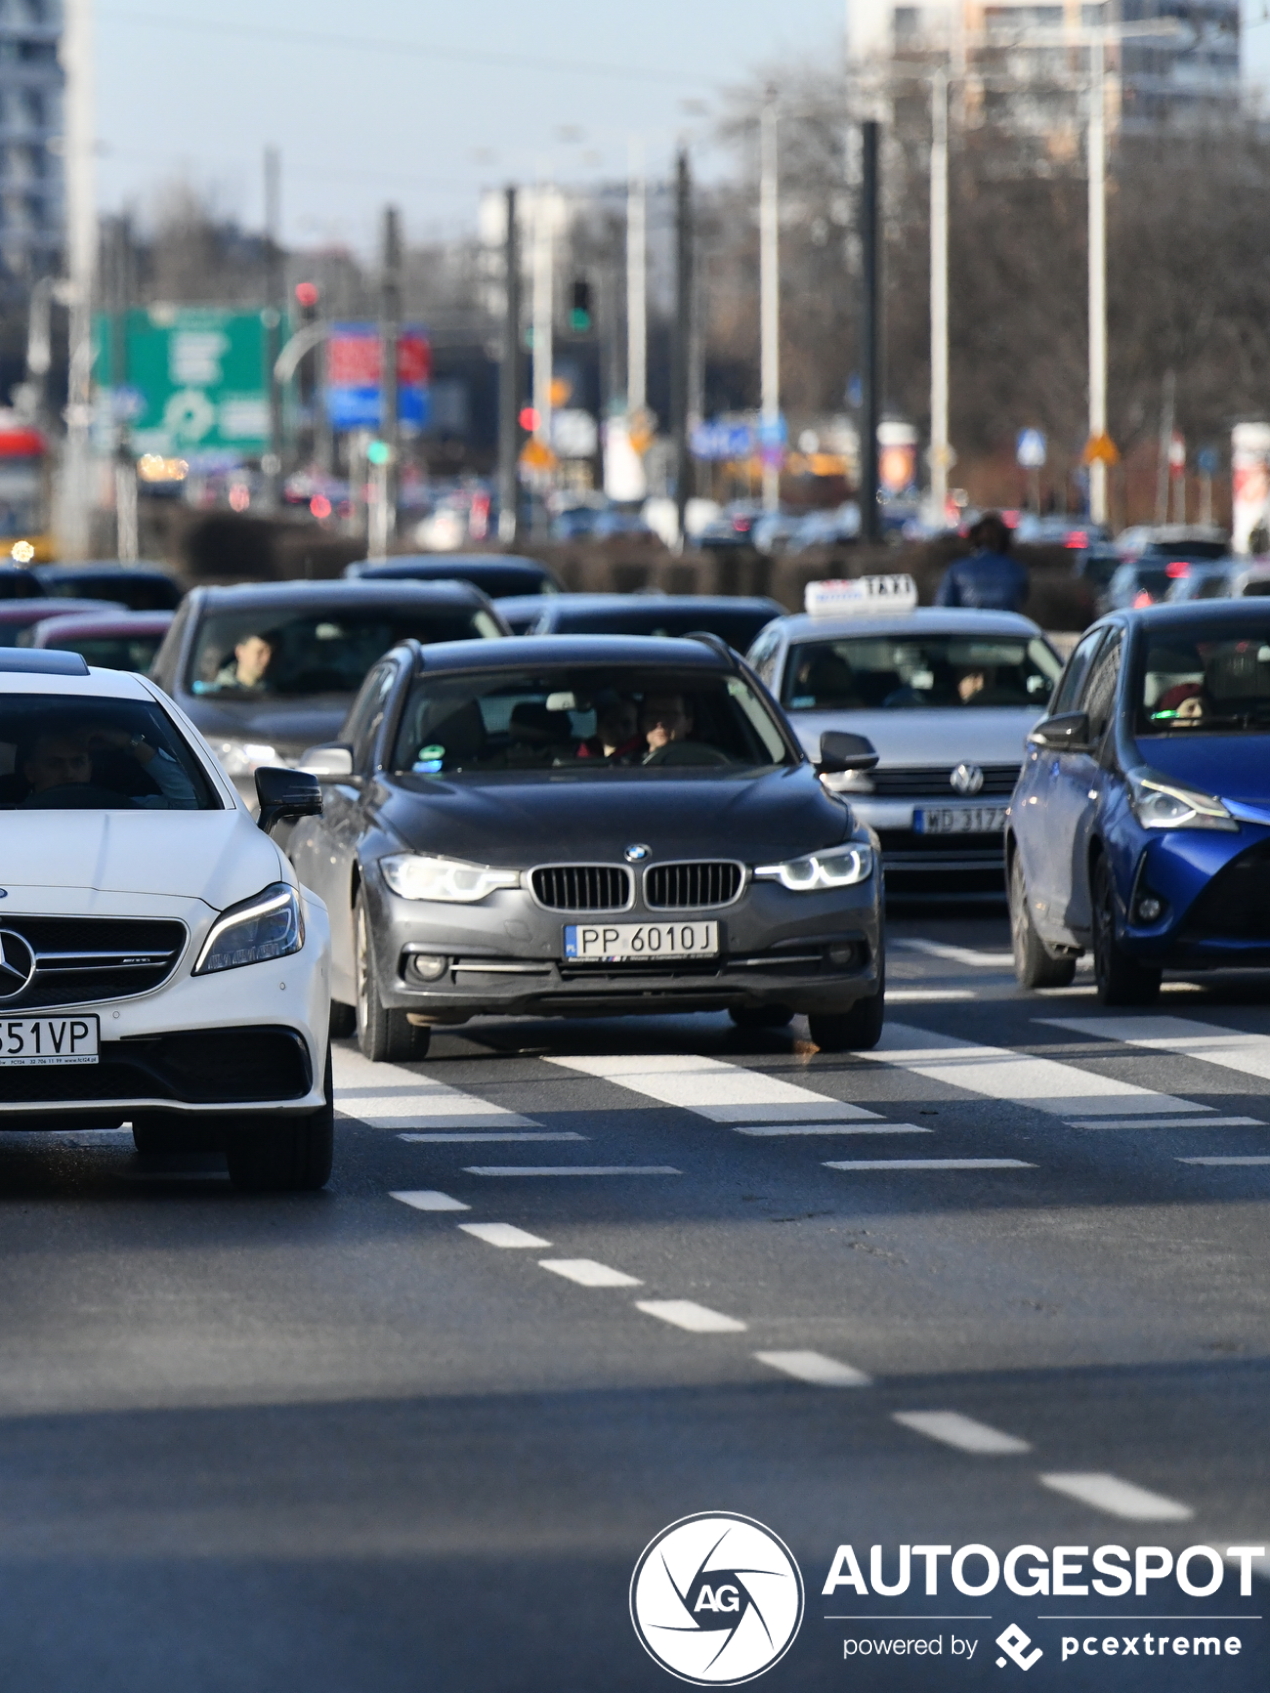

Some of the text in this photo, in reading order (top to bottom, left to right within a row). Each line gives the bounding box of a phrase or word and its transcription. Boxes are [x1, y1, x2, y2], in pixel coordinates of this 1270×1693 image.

[864, 575, 911, 595] TAXI
[582, 925, 710, 953] PP 6010J
